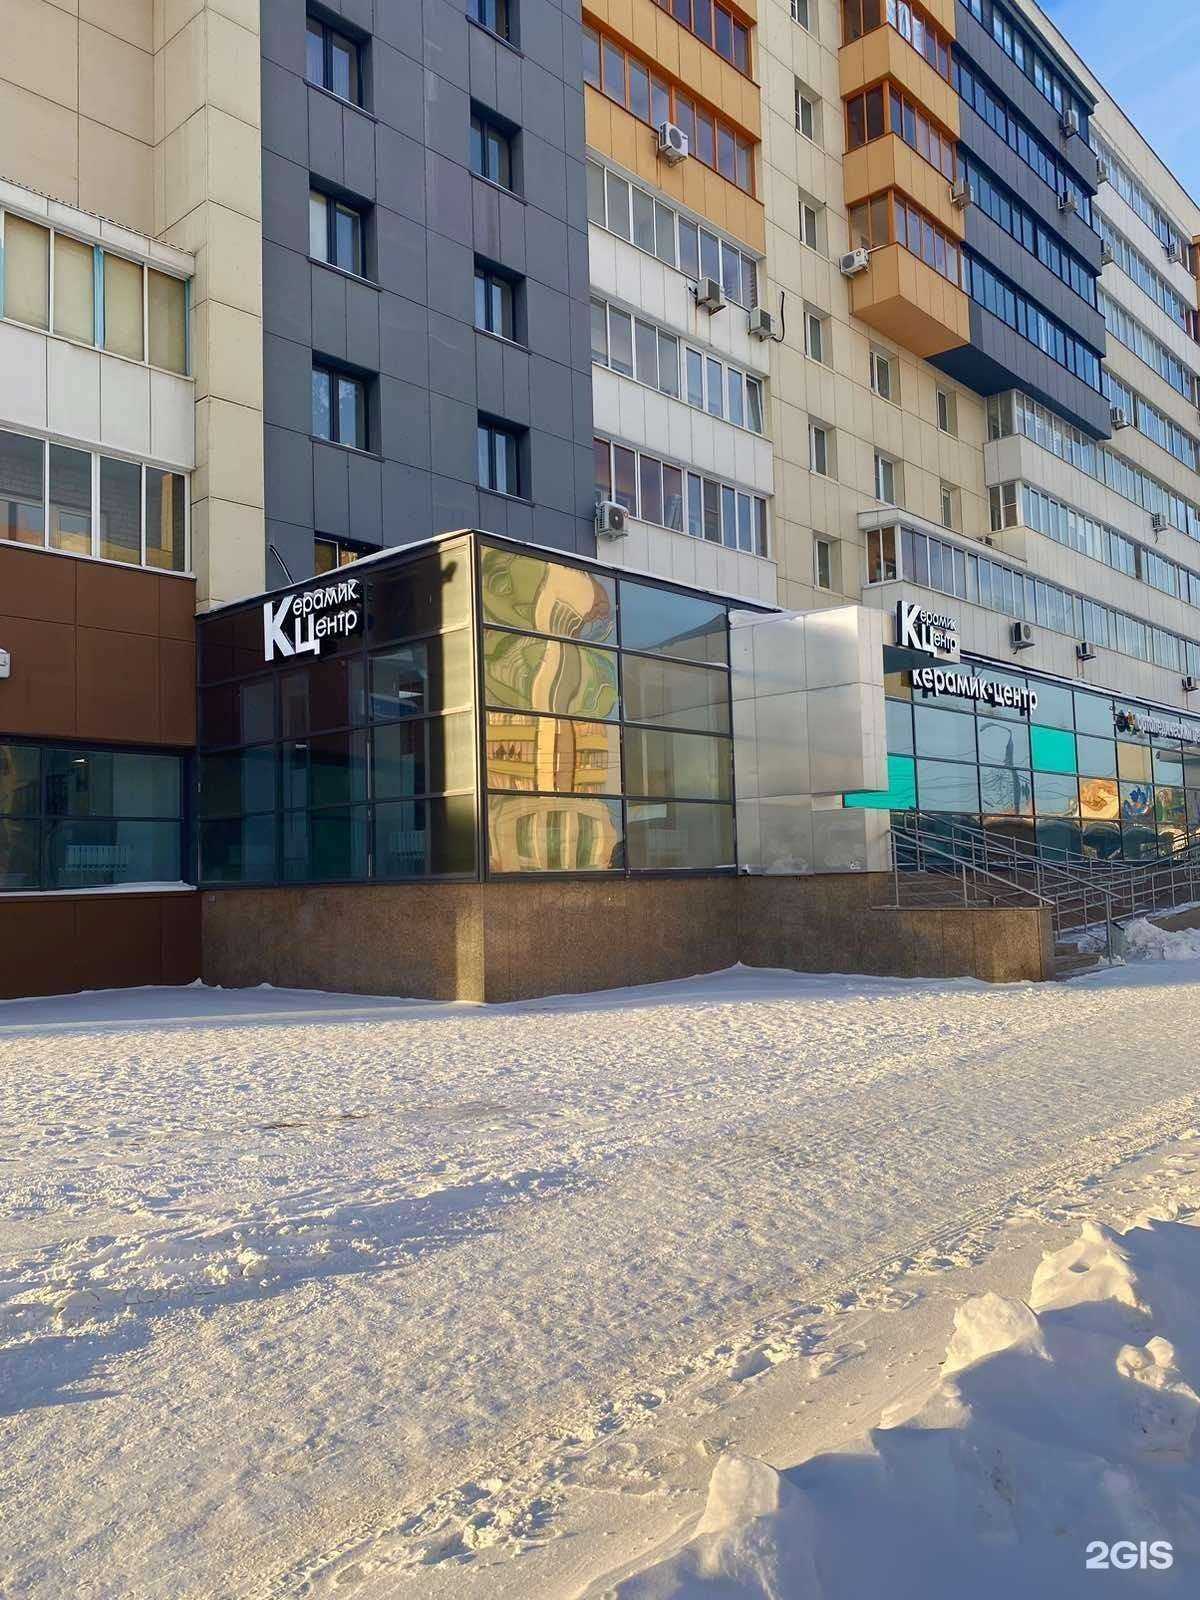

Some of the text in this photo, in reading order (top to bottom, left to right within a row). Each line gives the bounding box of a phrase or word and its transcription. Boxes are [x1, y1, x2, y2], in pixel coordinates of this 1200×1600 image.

[264, 579, 359, 661] Керамик
[295, 609, 358, 655] Центр
[901, 600, 957, 650] Керамик
[922, 623, 957, 658] Центр
